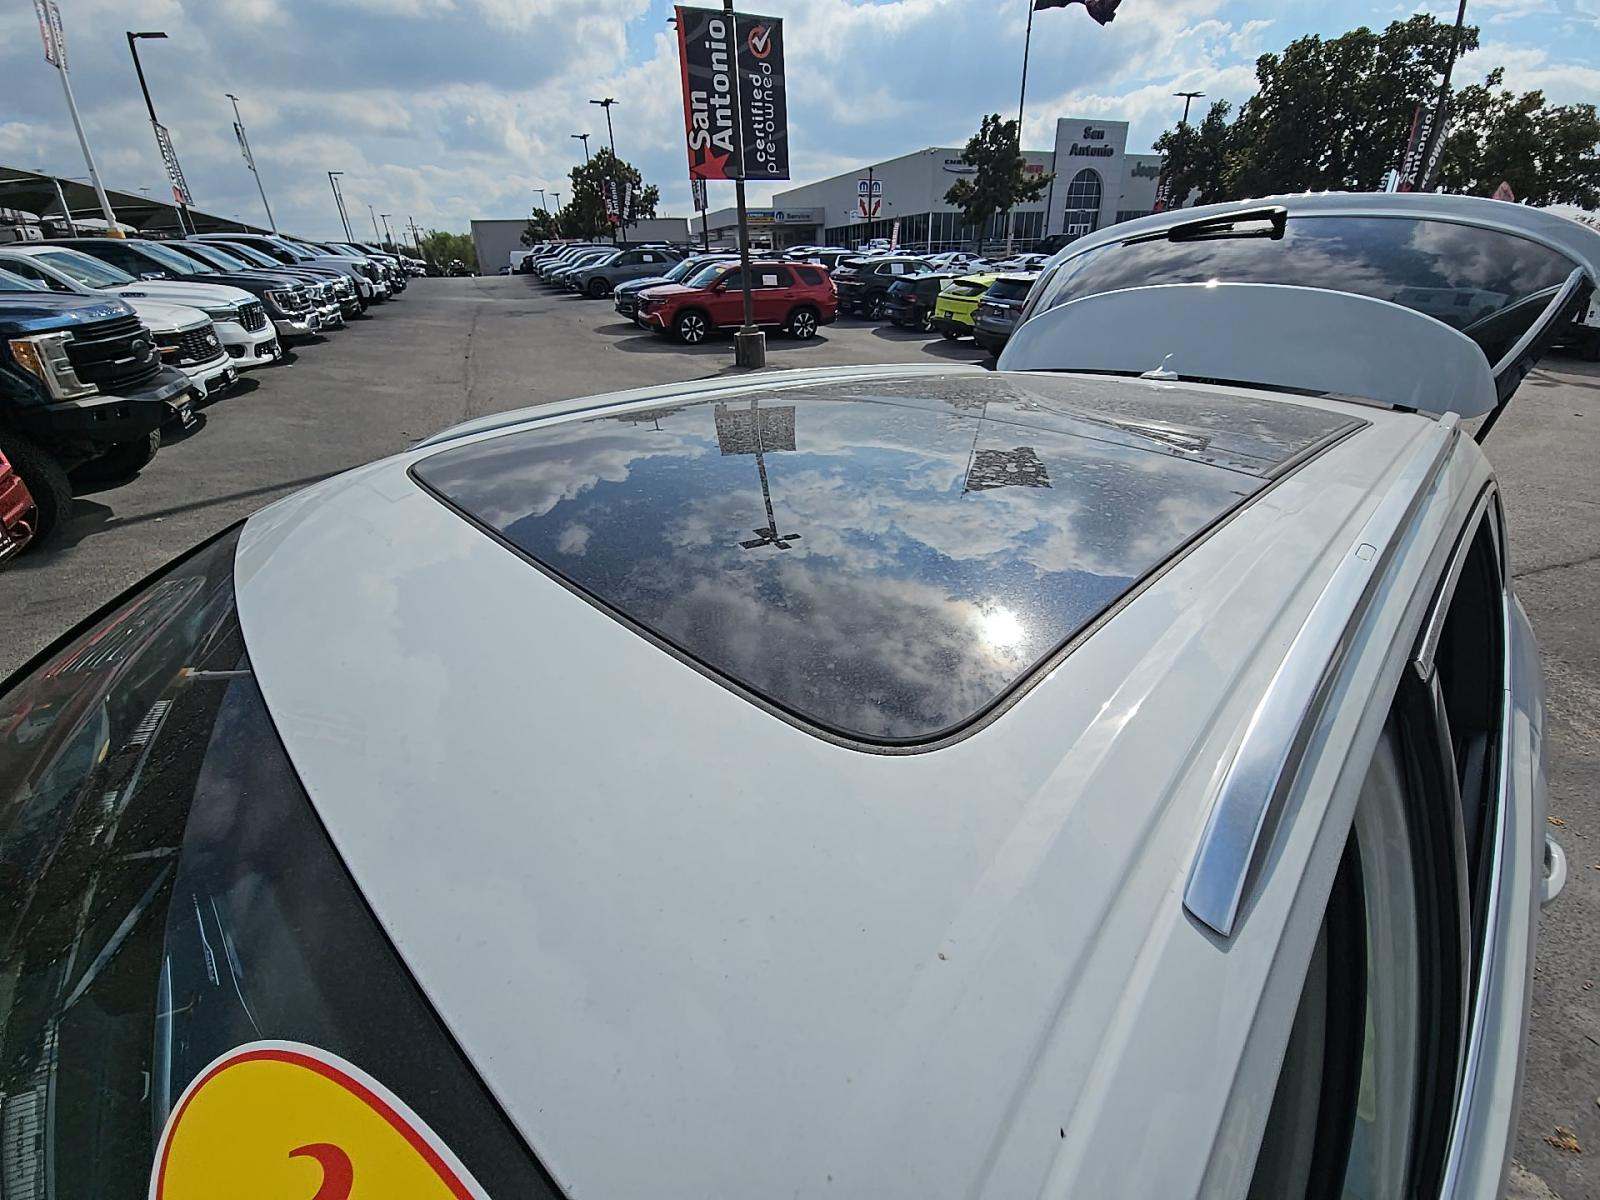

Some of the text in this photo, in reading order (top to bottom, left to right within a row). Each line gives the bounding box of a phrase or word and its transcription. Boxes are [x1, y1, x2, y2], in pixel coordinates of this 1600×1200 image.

[705, 19, 734, 152] Antonio
[689, 90, 711, 151] San
[749, 74, 765, 162] certified
[759, 62, 780, 174] pre-owned
[1083, 126, 1105, 140] San
[1069, 143, 1114, 157] Antonio
[1399, 151, 1415, 183] San
[1408, 114, 1432, 184] Antonio
[610, 181, 620, 215] Antonio
